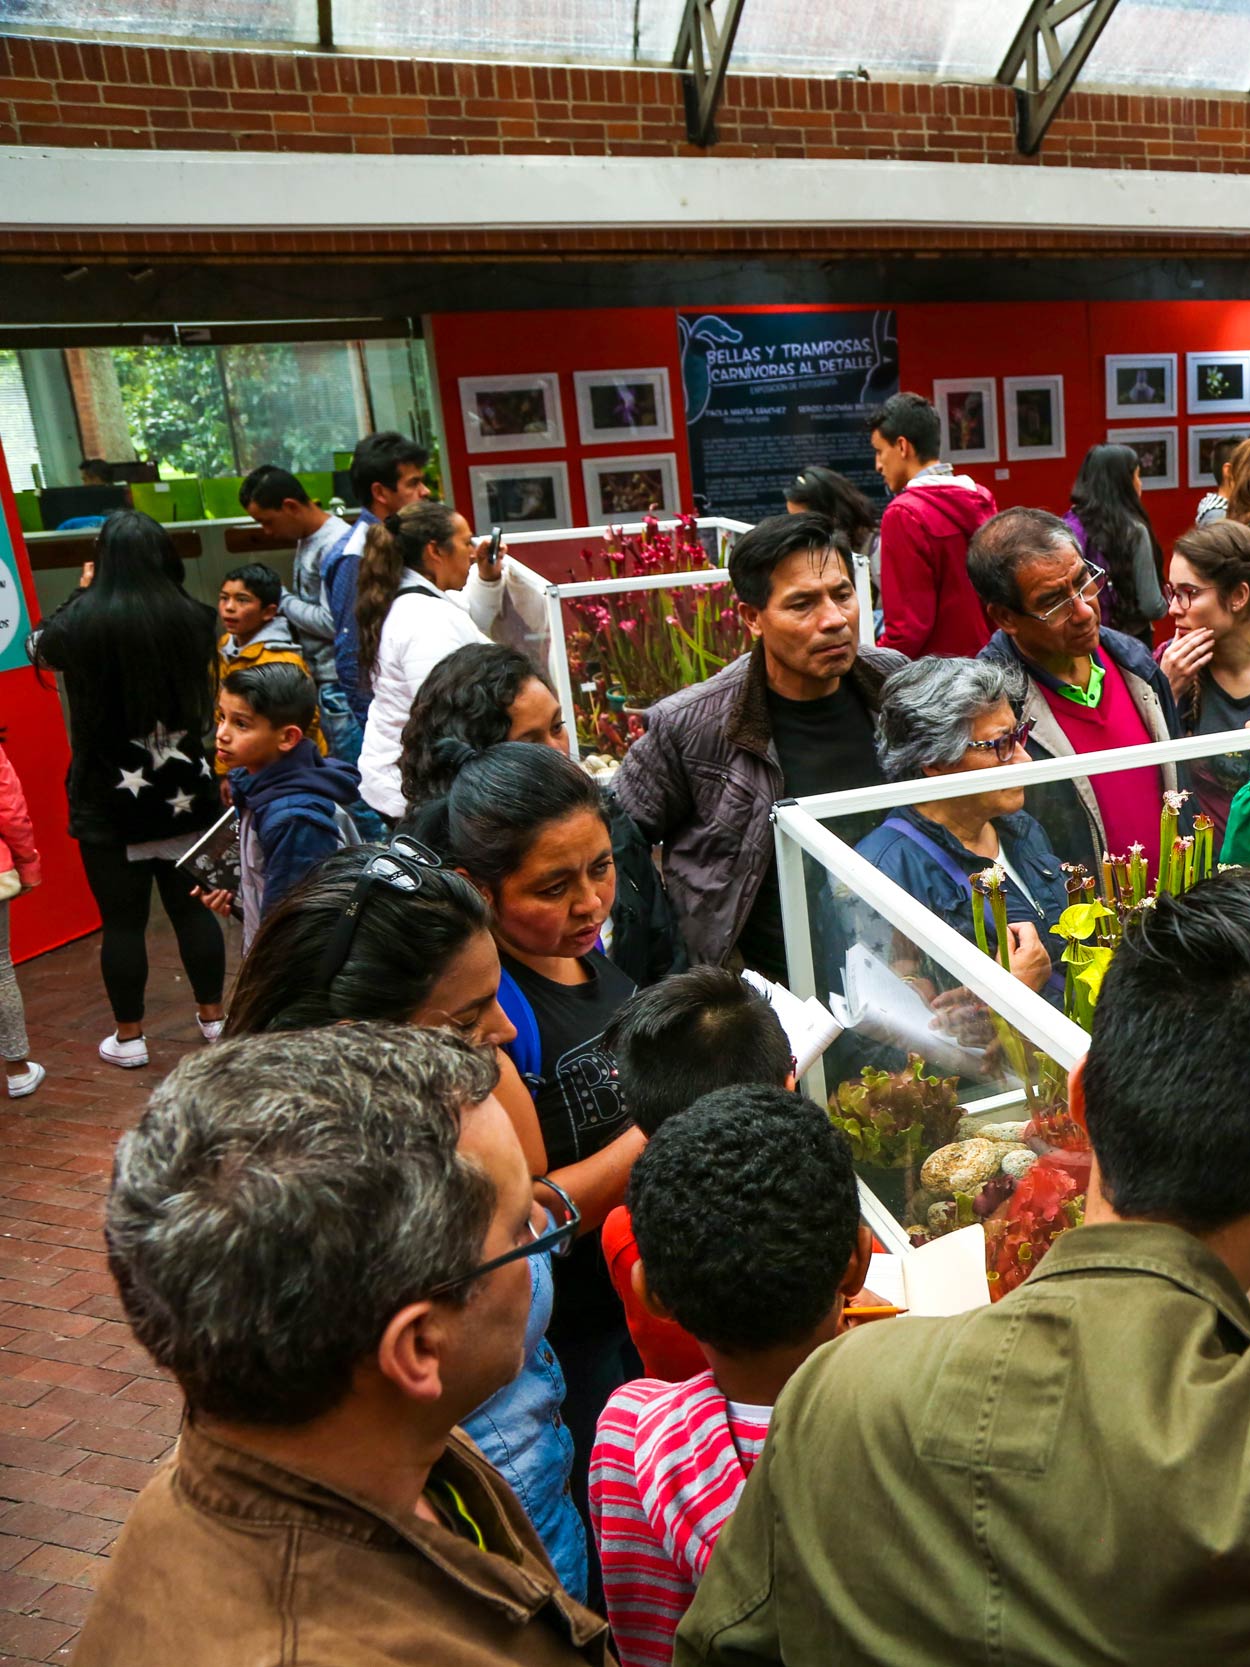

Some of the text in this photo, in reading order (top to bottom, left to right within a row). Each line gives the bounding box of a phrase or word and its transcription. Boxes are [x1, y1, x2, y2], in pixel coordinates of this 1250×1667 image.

[706, 346, 761, 365] BELLAS
[765, 345, 776, 359] Y
[711, 355, 873, 382] CARNÍVORAS AL DETALLE
